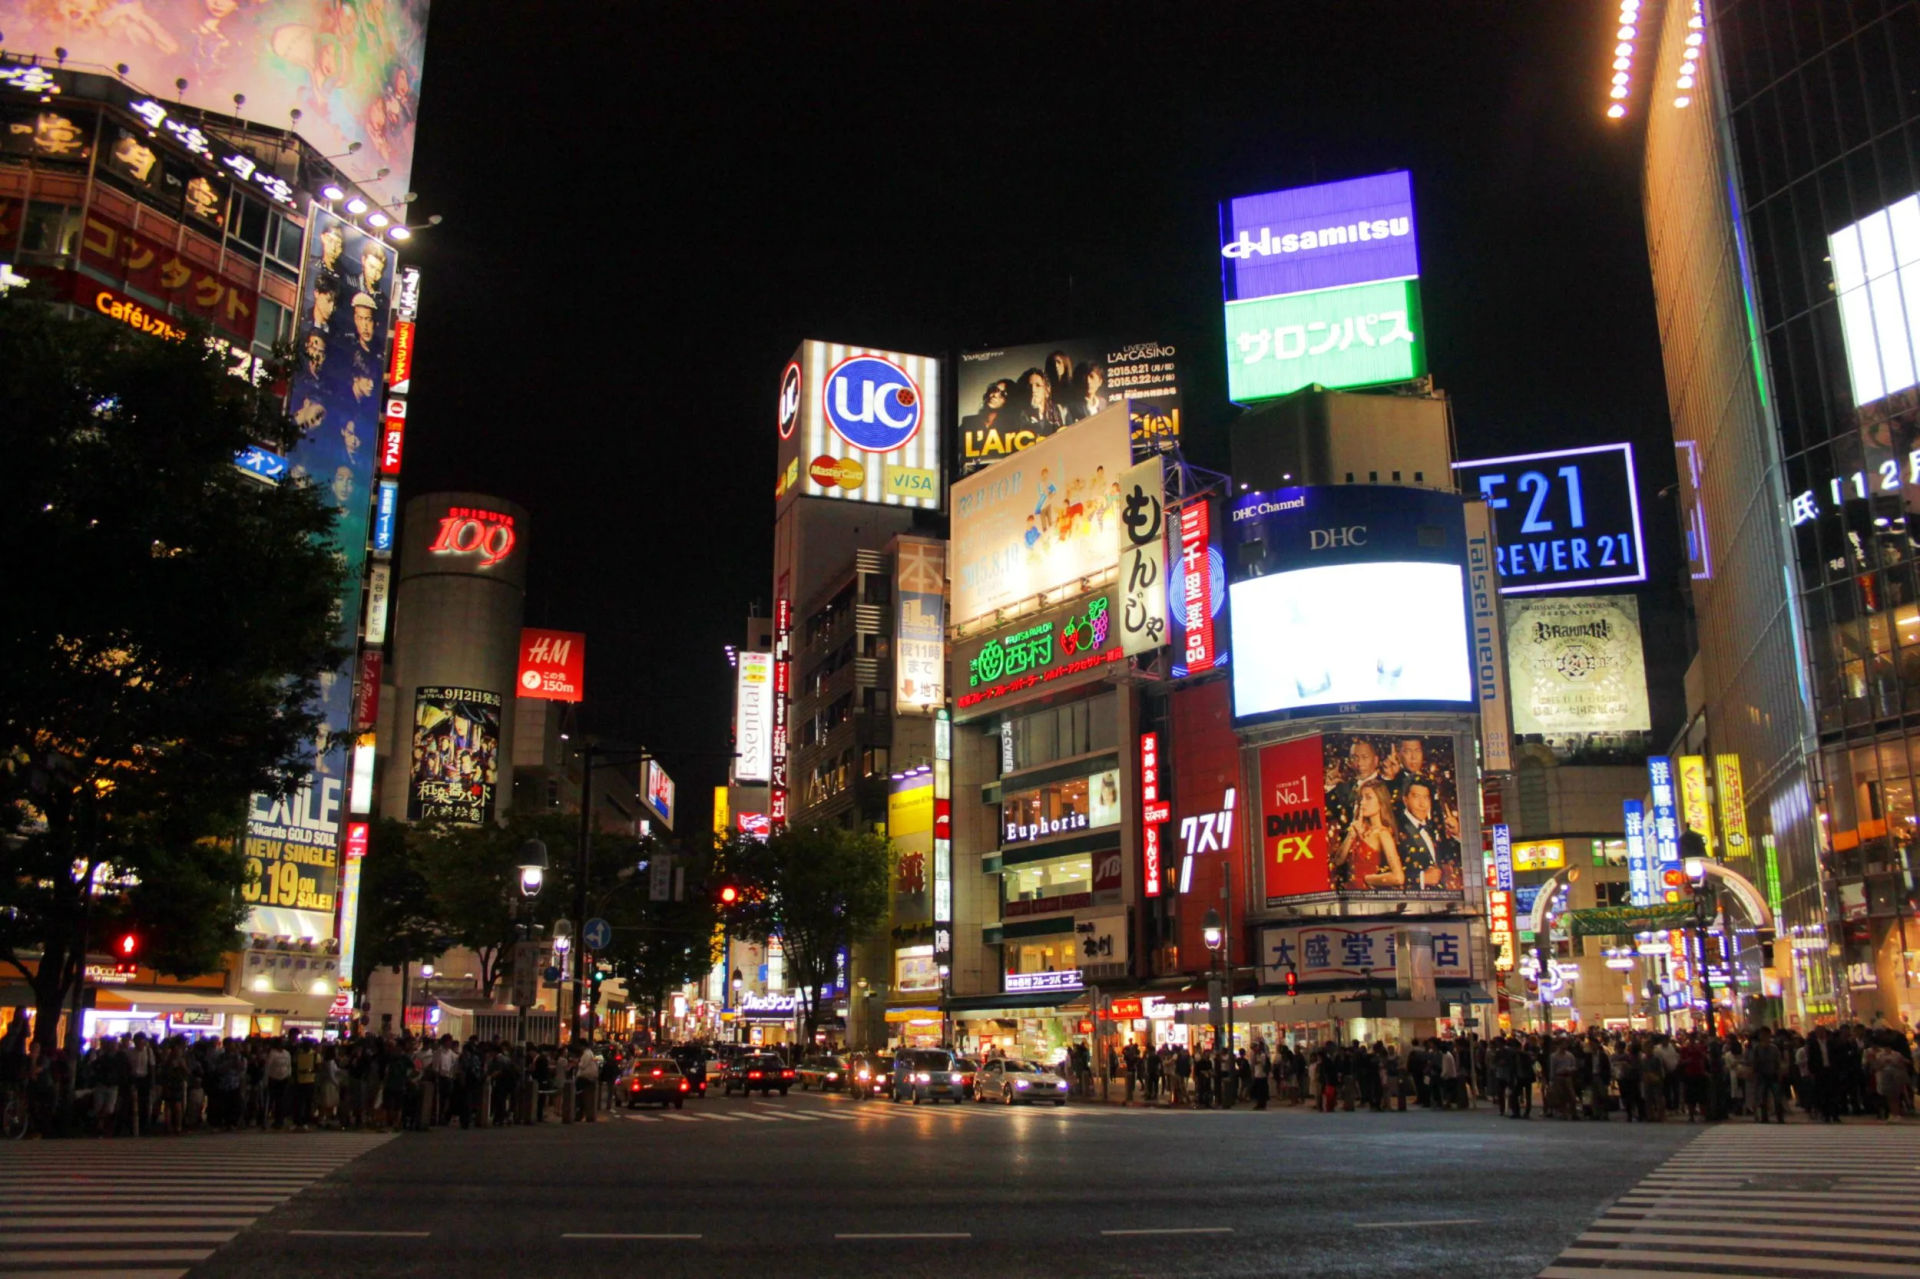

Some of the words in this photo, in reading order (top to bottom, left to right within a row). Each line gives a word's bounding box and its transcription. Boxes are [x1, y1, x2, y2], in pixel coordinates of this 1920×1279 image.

[1221, 216, 1410, 260] Hisamitsu
[82, 216, 250, 321] コンタクト
[1237, 310, 1414, 365] サロンパス
[809, 464, 864, 481] MasterCard
[894, 474, 933, 491] VISA
[449, 506, 514, 527] SHIBUYA
[1233, 505, 1257, 522] DHC
[1257, 496, 1305, 515] Channel
[428, 514, 516, 567] 109
[1310, 525, 1367, 550] DHC
[1597, 533, 1631, 566] 21
[1122, 484, 1165, 643] もんじゃ
[527, 636, 572, 667] H&M
[1477, 626, 1496, 701] neon
[542, 680, 574, 693] 150m
[248, 776, 342, 834] EXILE
[1276, 775, 1311, 808] No.1
[288, 827, 312, 843] GOLD
[313, 831, 337, 848] SOUL
[1006, 813, 1087, 841] Euphoria
[1266, 807, 1323, 838] DMM
[245, 838, 281, 860] NEW
[283, 844, 336, 868] SINGLE
[1276, 834, 1315, 863] FX
[299, 877, 316, 893] ON
